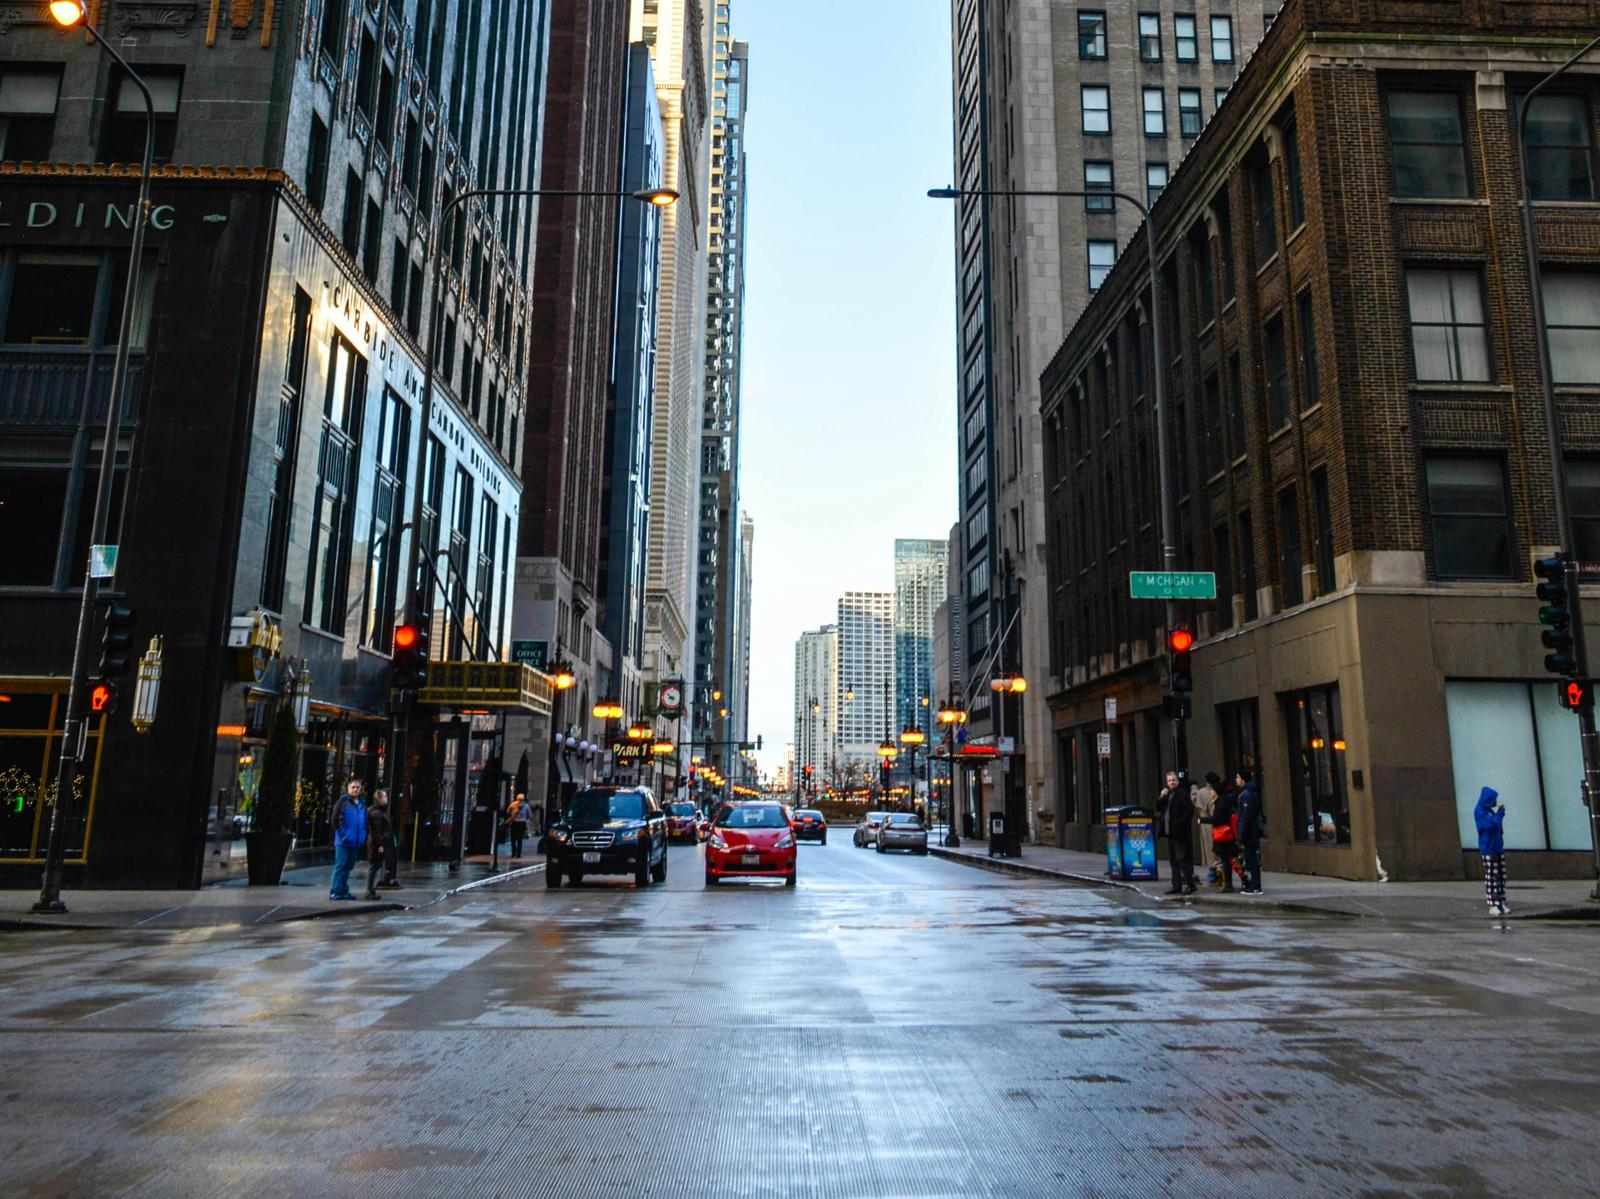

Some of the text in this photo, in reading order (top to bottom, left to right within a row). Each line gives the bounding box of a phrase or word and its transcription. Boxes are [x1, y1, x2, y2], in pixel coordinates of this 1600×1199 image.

[1146, 576, 1194, 586] MCHIGAN
[952, 597, 960, 681] Hilton Garden Inn
[613, 743, 639, 757] PARK
